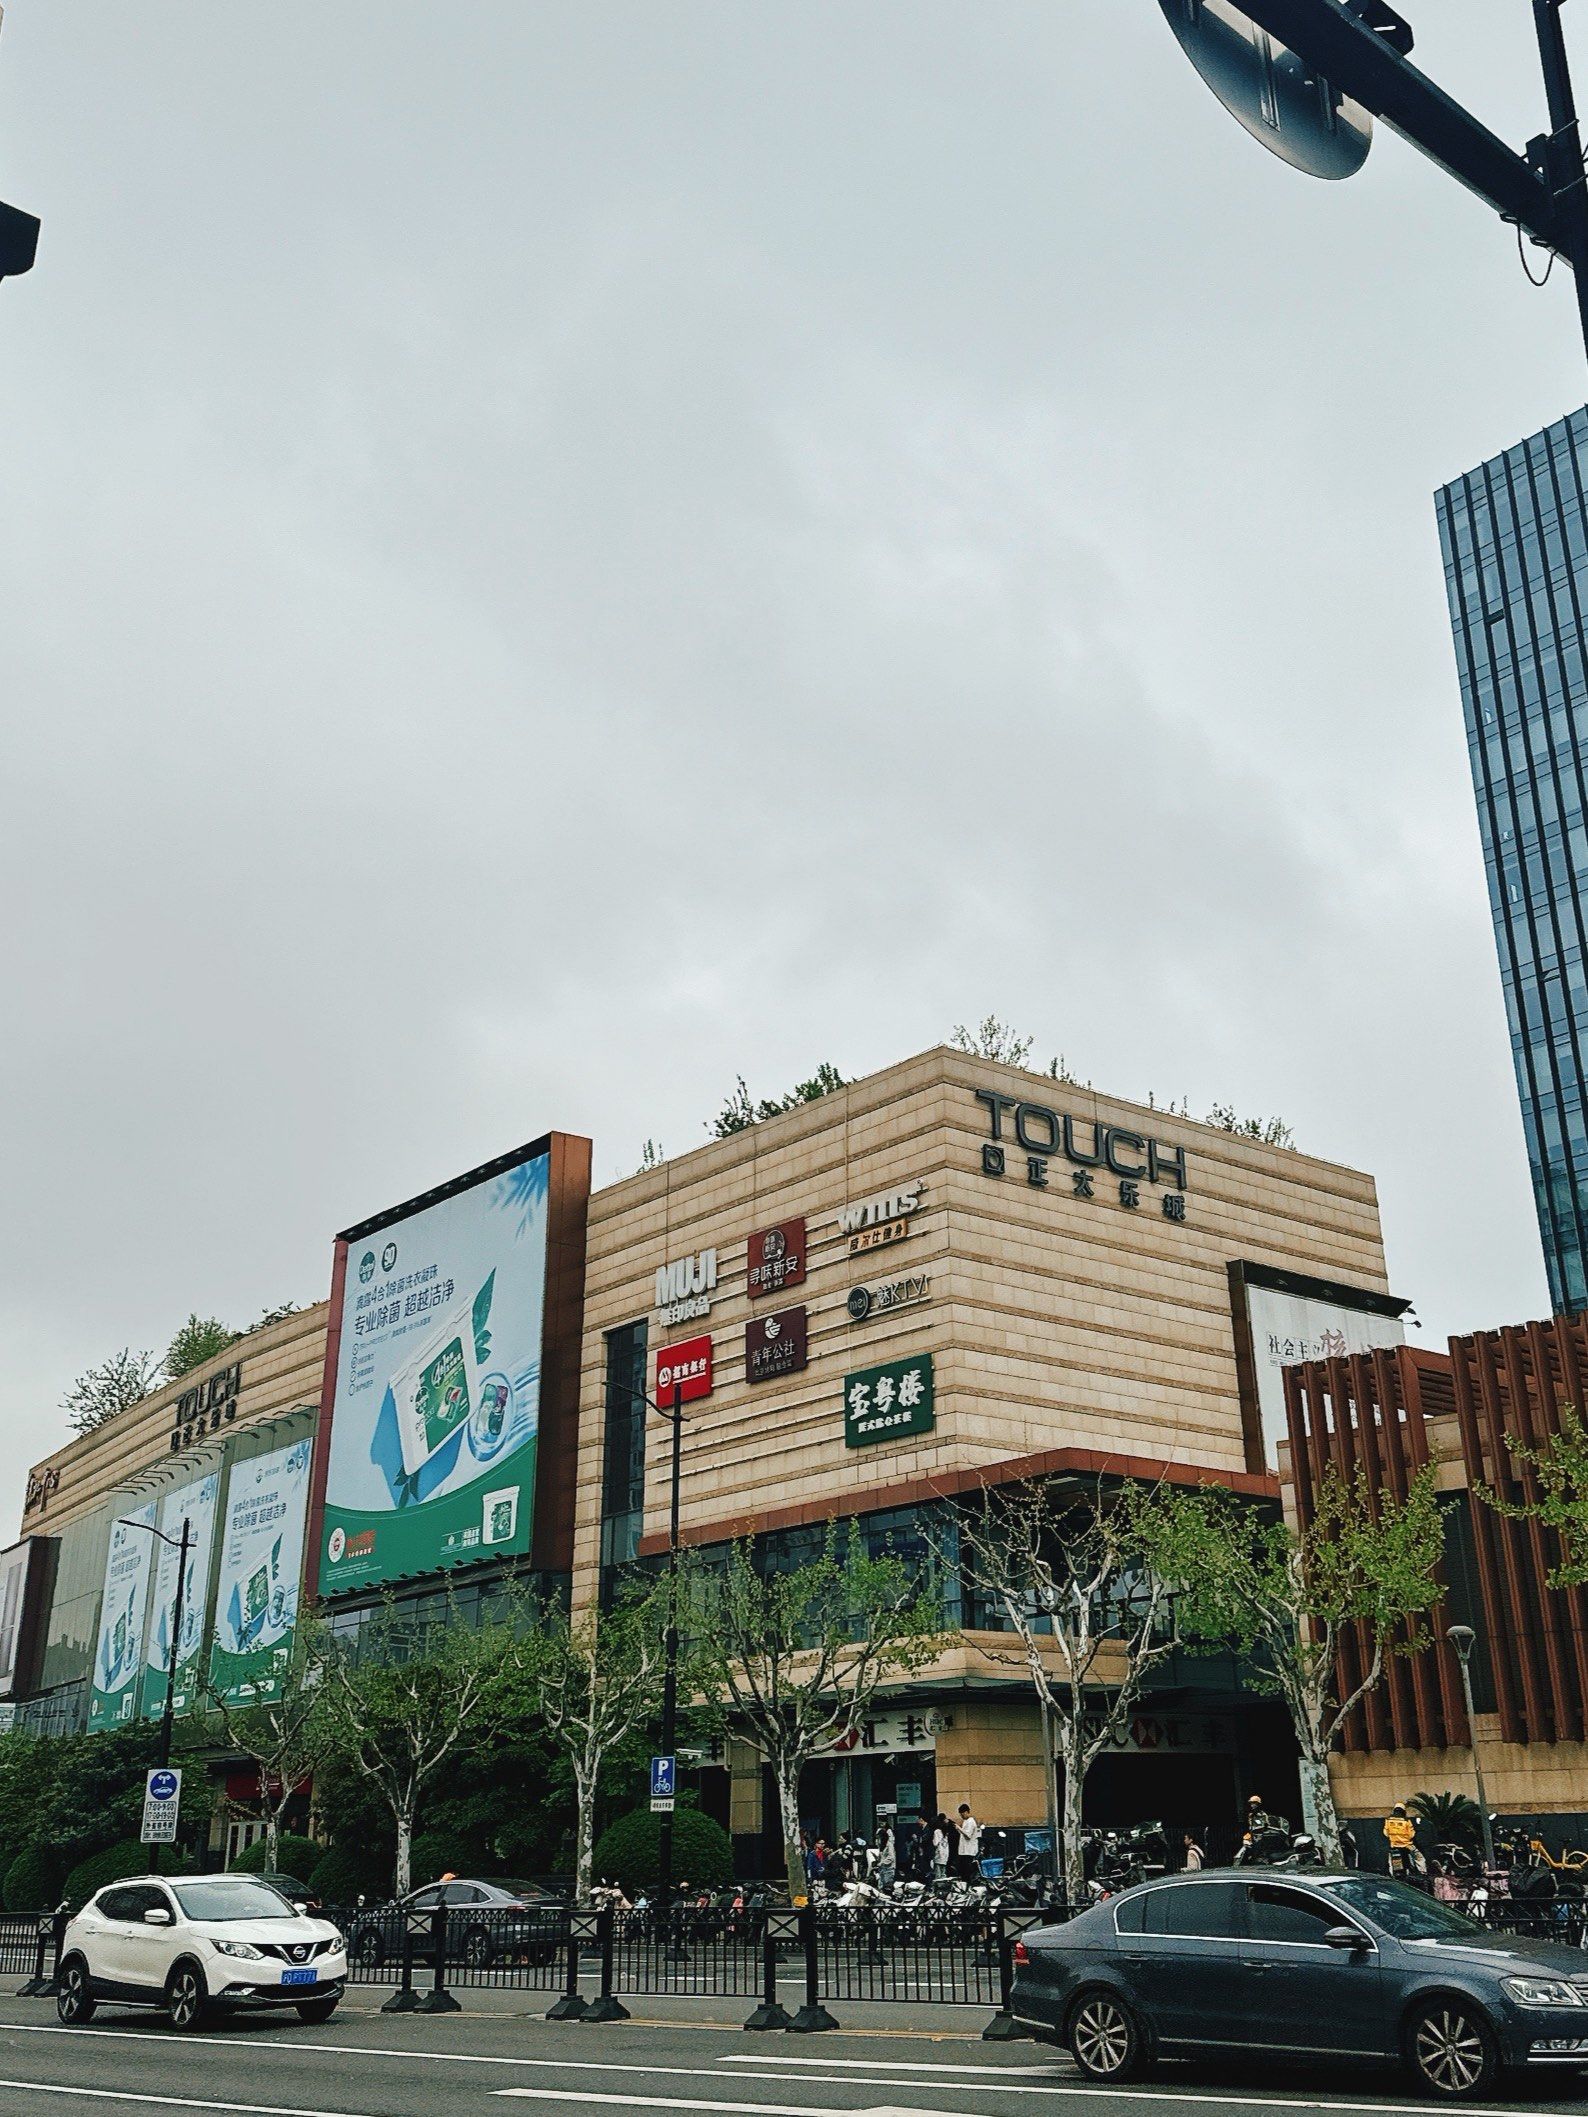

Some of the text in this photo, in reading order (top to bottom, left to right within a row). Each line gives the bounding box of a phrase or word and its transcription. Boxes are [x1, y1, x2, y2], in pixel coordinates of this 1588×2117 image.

[975, 1088, 1187, 1190] TOUCH
[655, 1248, 717, 1307] MUJI
[749, 1256, 798, 1286] 寻味新安
[355, 1300, 401, 1336] 专业除菌
[404, 1278, 454, 1318] 超越洁净
[751, 1338, 796, 1366] 青年公社
[175, 1362, 241, 1427] TOUCH
[861, 1714, 926, 1749] 汇丰
[658, 1760, 669, 1776] P
